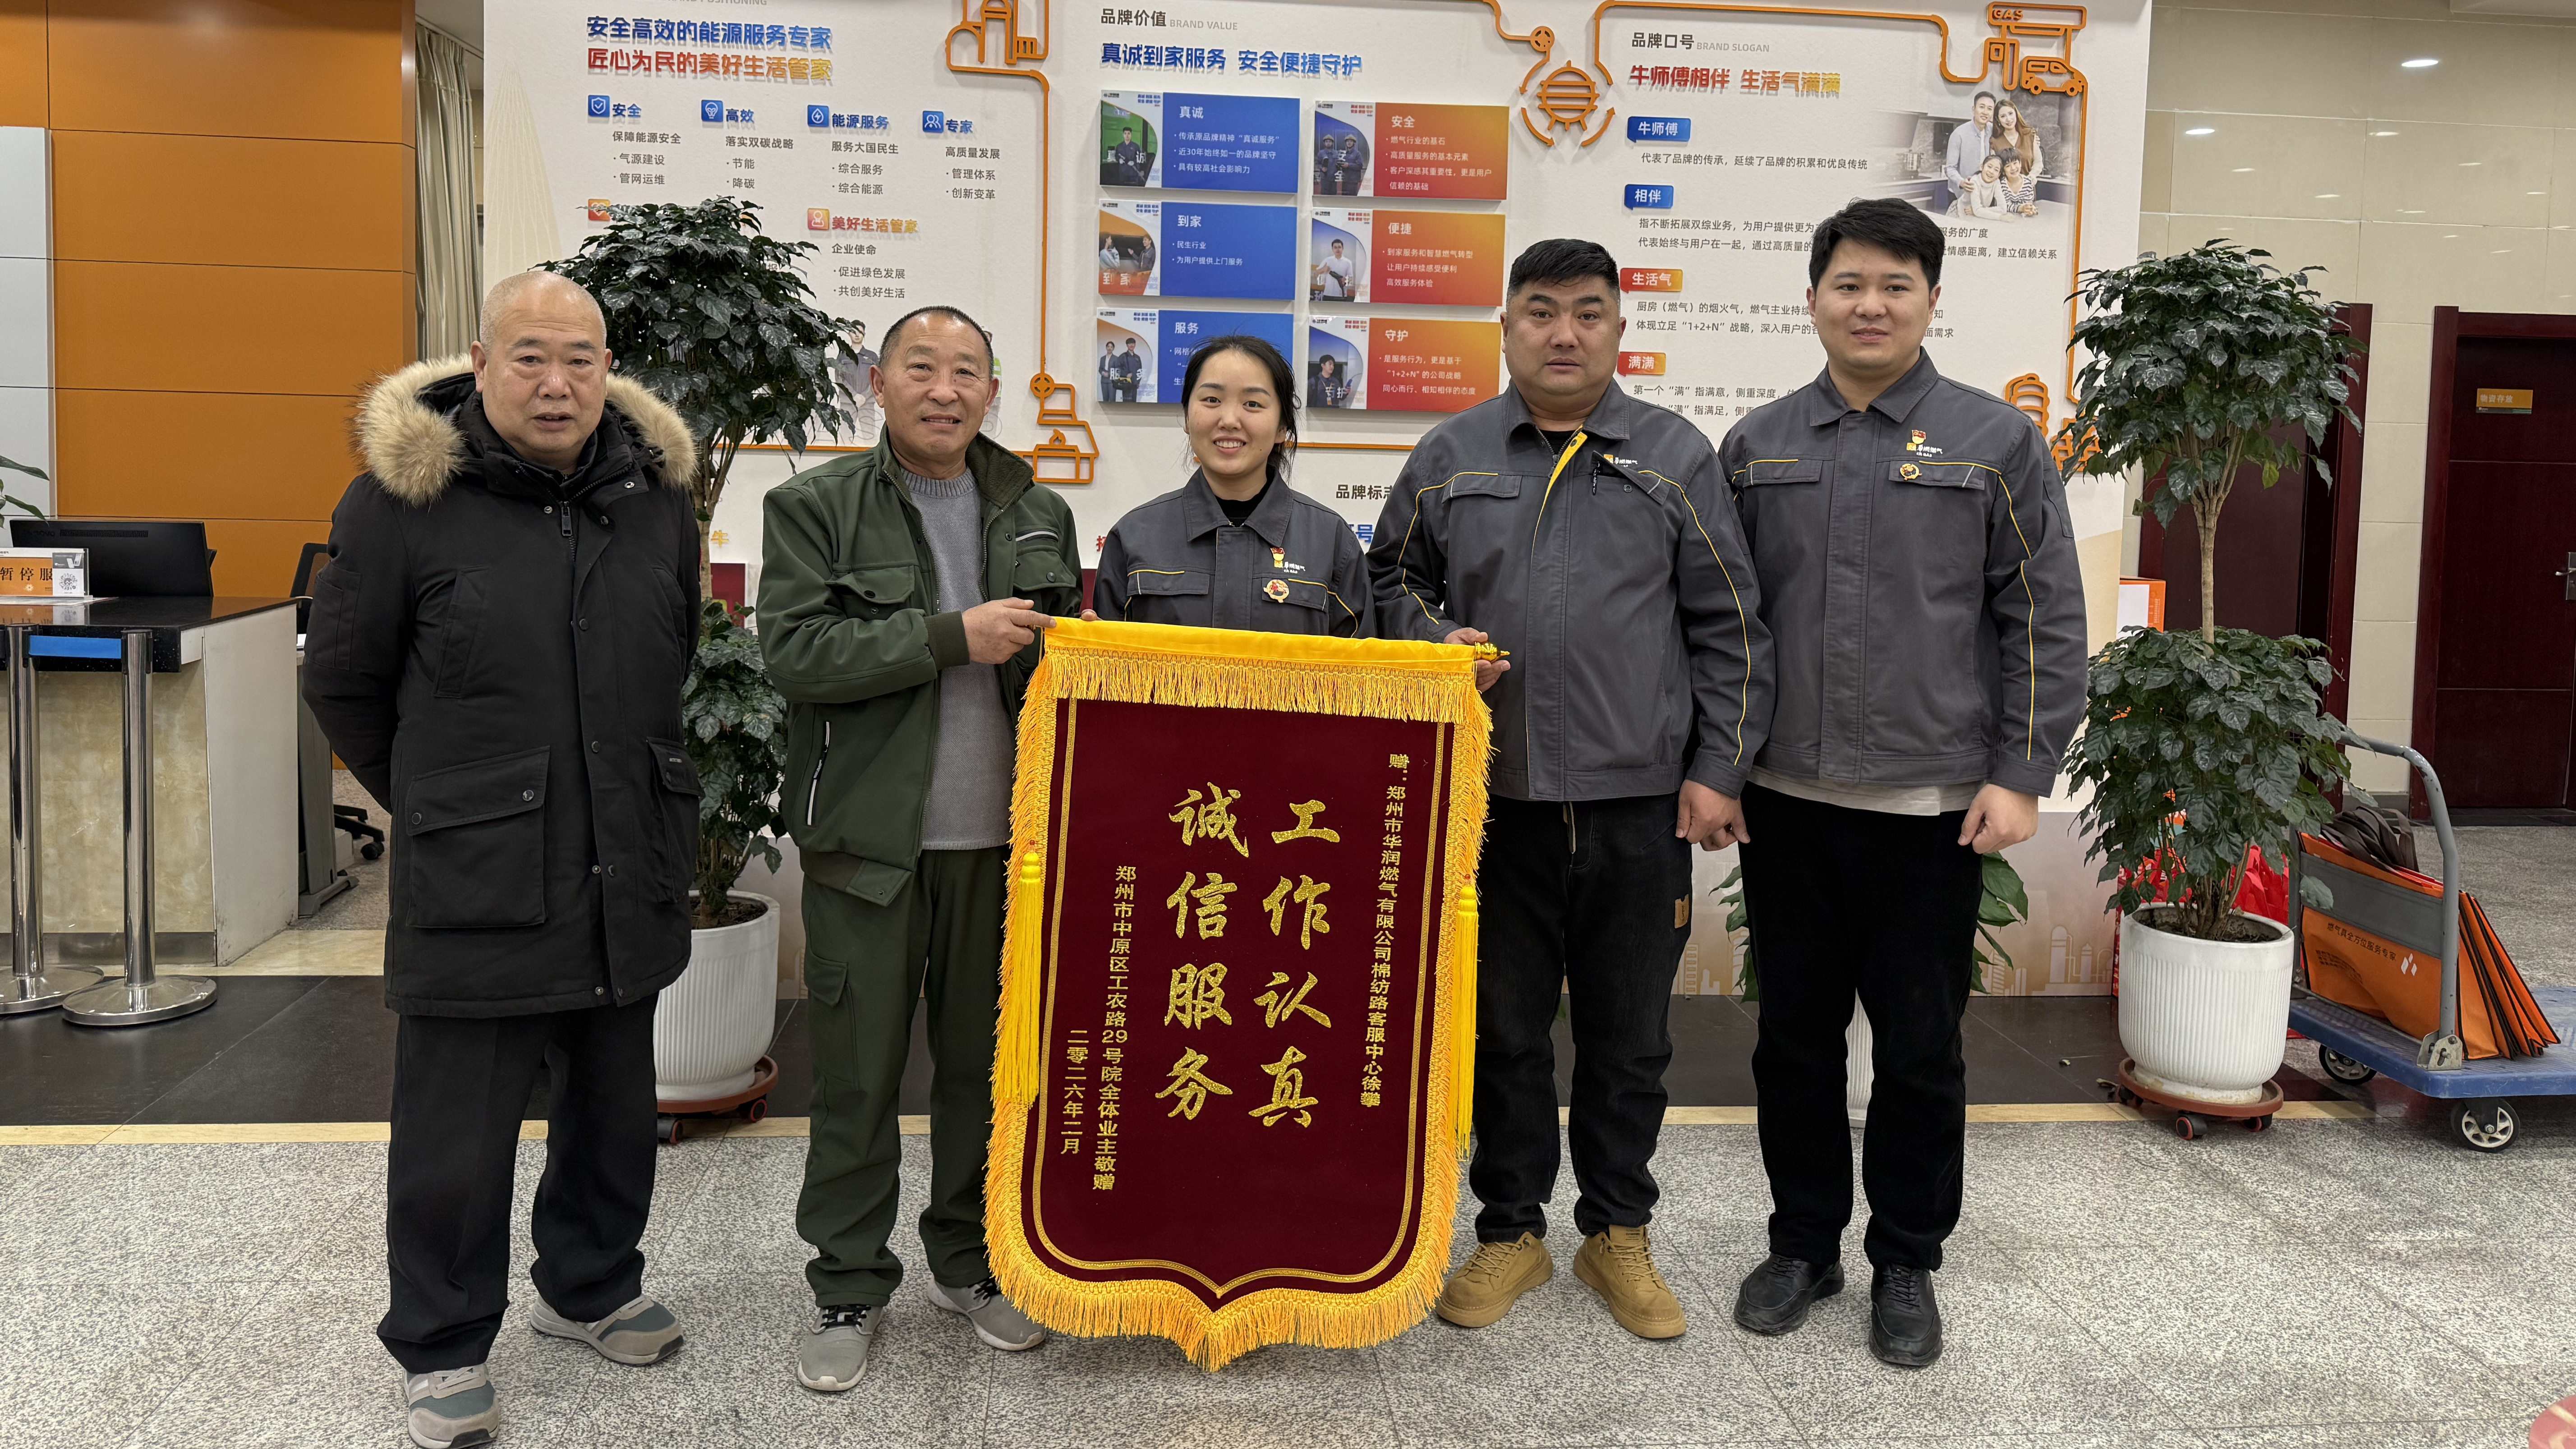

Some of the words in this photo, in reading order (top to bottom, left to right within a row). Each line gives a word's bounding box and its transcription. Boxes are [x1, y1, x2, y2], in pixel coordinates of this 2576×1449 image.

[1101, 8, 1166, 27] 品牌价值
[1170, 19, 1204, 28] BRAND
[1207, 21, 1238, 30] VALUE
[1994, 9, 2023, 20] GAS
[587, 16, 831, 49] 安全高效的能源服务专家
[1632, 32, 1694, 50] 品牌口号
[1697, 42, 1730, 51] BRAND
[1732, 43, 1770, 53] SLOGAN
[588, 48, 831, 81] 匠心为民的美好生活管家
[1102, 43, 1226, 70] 真诚到家服务
[1238, 50, 1362, 76] 安全便捷守护
[1630, 65, 1730, 89] 牛师傅相伴
[1740, 69, 1840, 93] 生活气满满
[612, 103, 641, 118] 安全
[726, 109, 754, 123] 高效
[1179, 106, 1204, 119] 真诚
[832, 114, 889, 130] 能源服务
[946, 119, 973, 133] 专家
[1391, 115, 1415, 128] 安全
[1638, 122, 1678, 136] 牛师傅
[612, 131, 681, 144] 保障能源安全
[726, 136, 794, 149] 落实双碳战略
[1390, 136, 1445, 146] 燃气行业的基石
[832, 141, 899, 155] 服务大国民生
[945, 147, 1000, 159] 高质量发展
[1178, 147, 1276, 160] 近30年始终如一的品牌坚守
[620, 153, 665, 166] 气源建设
[1390, 151, 1468, 162] 高质量服务的基本元素
[1641, 152, 1868, 170] 代表了品牌的传承，延续了品牌的积累和优良传统
[732, 158, 755, 169] 节能
[838, 163, 883, 175] 综合服务
[1178, 163, 1250, 174] 具有较高社会影响力
[620, 173, 665, 185] 管网运维
[952, 168, 996, 180] 管理体系
[732, 178, 755, 189] 降碳
[838, 183, 883, 194] 综合能源
[1389, 182, 1429, 191] 信赖的基础
[952, 188, 996, 200] 创新变革
[1634, 189, 1661, 203] 相伴
[832, 216, 919, 233] 美好生活管家
[1178, 215, 1201, 227] 到家
[1639, 218, 1819, 234] 指不断拓展双综业务，为用户提供更为
[1388, 222, 1412, 235] 便捷
[832, 244, 877, 255] 企业使命
[1177, 240, 1206, 249] 民生行业
[1387, 248, 1473, 259] 到家服务和智慧燃气转型
[1177, 256, 1243, 266] 为用户提供上门服务
[838, 266, 906, 280] 促进绿色发展
[1387, 263, 1457, 273] 让用户持续感受便利
[1386, 278, 1433, 288] 高效服务体验
[1632, 272, 1672, 287] 生活气
[838, 285, 906, 299] 共创美好生活
[1174, 322, 1199, 334] 服务
[1924, 327, 1954, 338] 面需求
[1385, 329, 1408, 342] 守护
[1384, 355, 1462, 365] 是服务行为，更是基于
[1628, 355, 1655, 369] 满满
[1383, 385, 1477, 396] 同心而行、相知相伴的态度
[711, 529, 730, 547] 牛
[1348, 524, 1375, 543] 号
[1155, 782, 1249, 1120] 诚信服务
[1249, 798, 1340, 1128] 工作认真
[1092, 865, 1136, 1191] 郑州市中原区工农路29号院全体业主敬赠
[1061, 1030, 1089, 1154] 二零二六年二月
